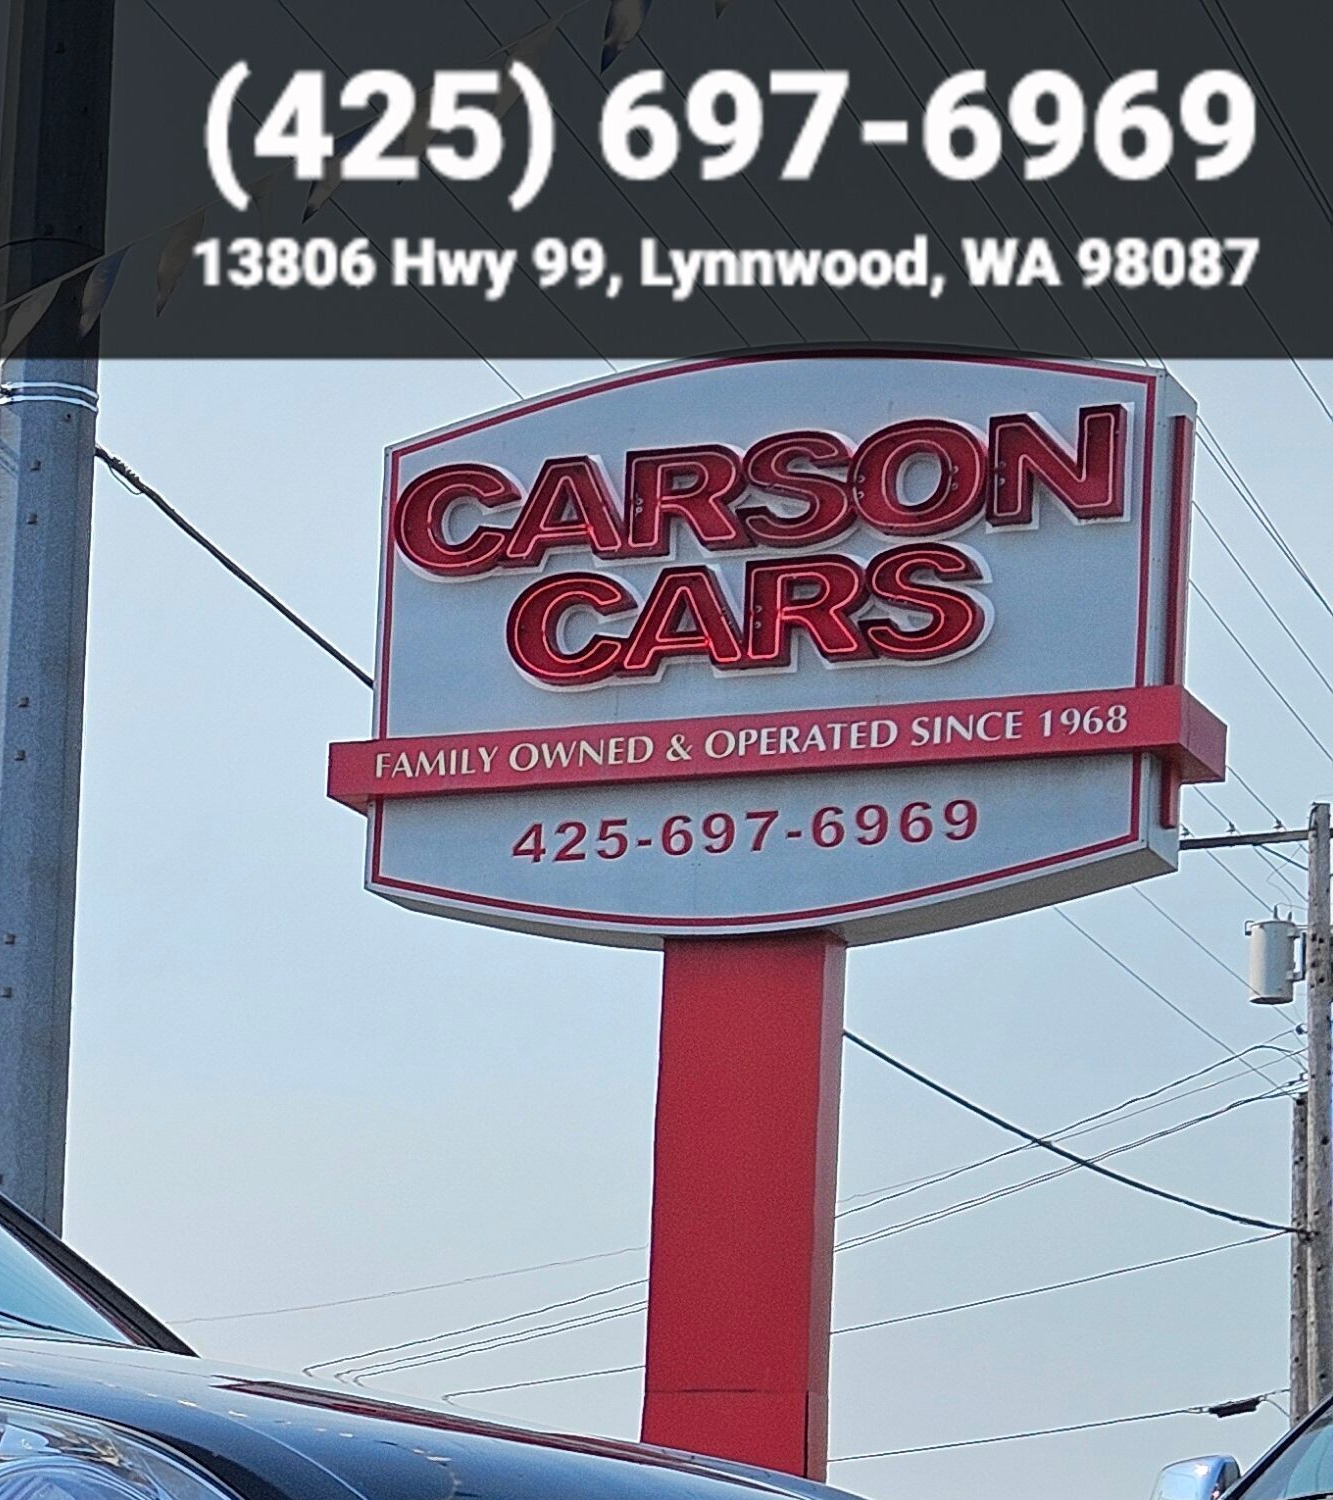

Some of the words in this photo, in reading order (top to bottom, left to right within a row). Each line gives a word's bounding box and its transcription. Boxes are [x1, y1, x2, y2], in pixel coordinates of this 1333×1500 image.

[394, 404, 1130, 578] CARSON
[505, 542, 990, 686] CARS
[374, 745, 499, 779] FAMILY
[508, 735, 654, 772] OWNED
[665, 733, 693, 763] &
[704, 718, 899, 759] OPERATED
[909, 710, 1024, 749] SINCE
[1037, 704, 1128, 738] 1968
[511, 799, 980, 864] 425-697-6969
